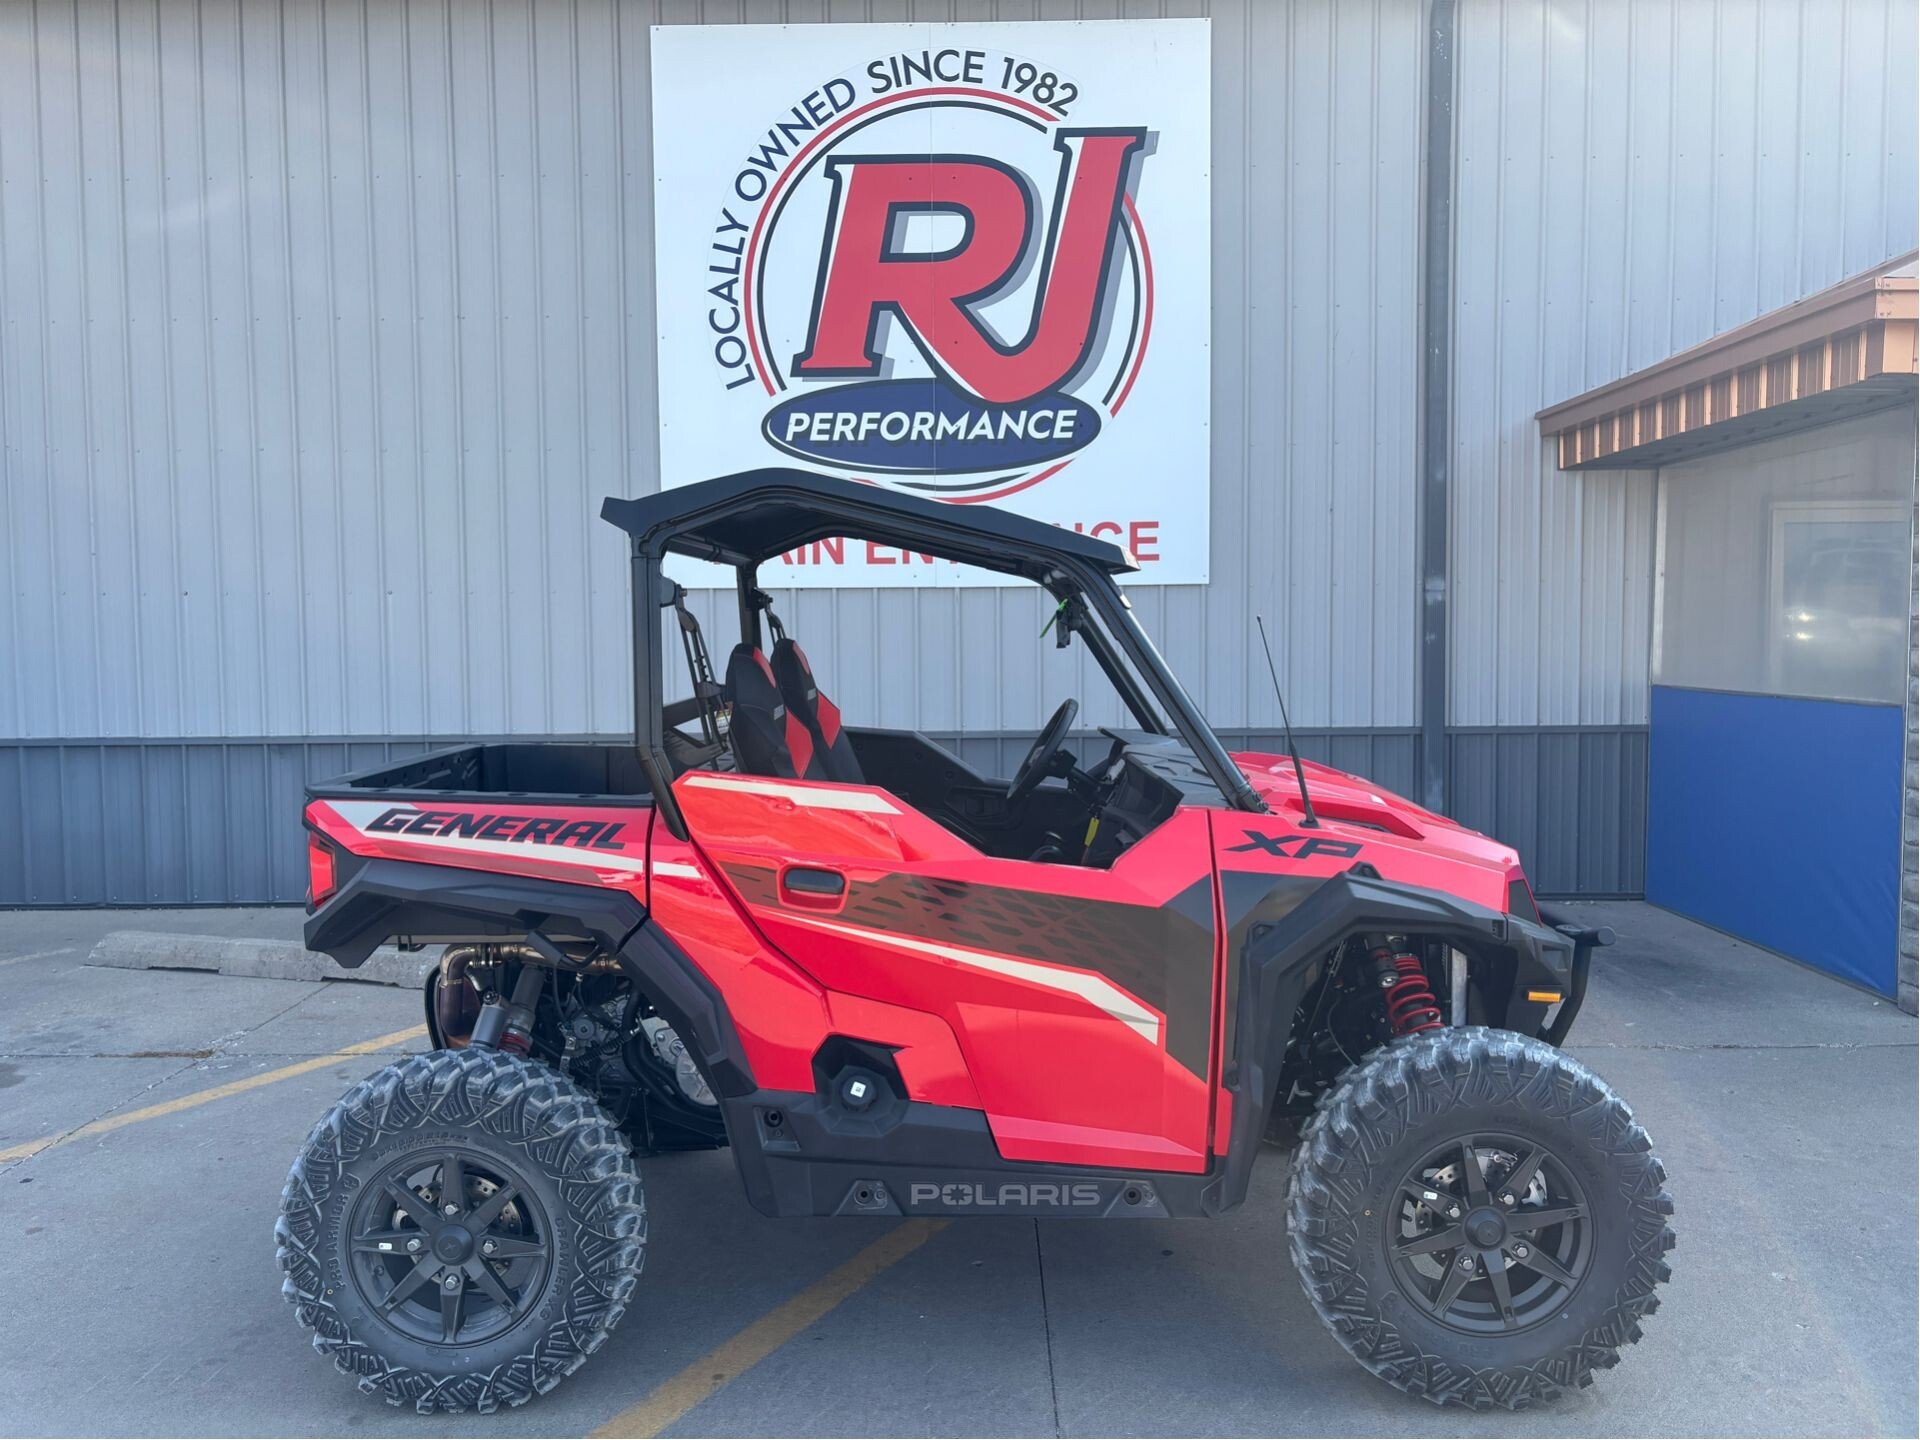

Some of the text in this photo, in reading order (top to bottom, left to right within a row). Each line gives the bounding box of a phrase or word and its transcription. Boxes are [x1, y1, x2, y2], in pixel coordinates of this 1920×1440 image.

[708, 49, 1078, 390] LOCALLY OWNED SINCE 1982
[790, 126, 1149, 406] RJ
[785, 409, 1078, 442] PERFORMANCE
[364, 808, 627, 850] GENERAL
[1224, 830, 1364, 859] XP
[910, 1183, 1100, 1206] POLARIS
[552, 1218, 569, 1296] CRAWLER
